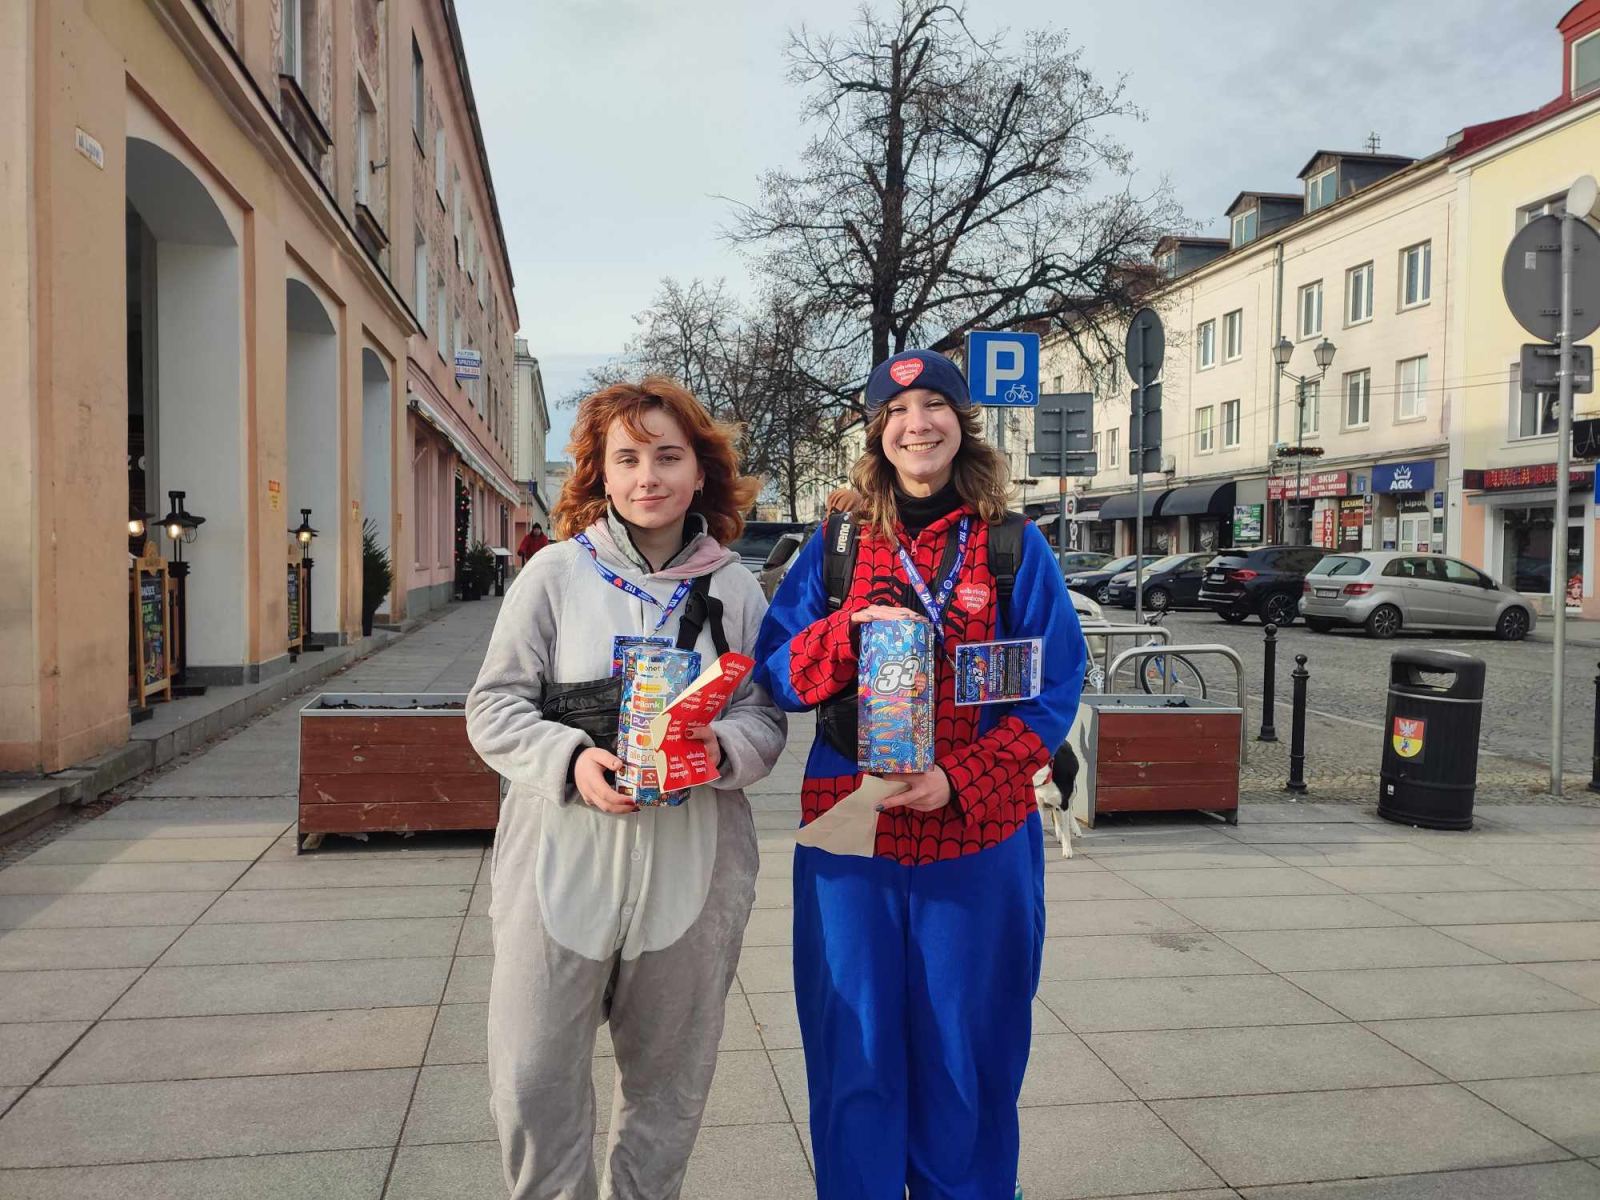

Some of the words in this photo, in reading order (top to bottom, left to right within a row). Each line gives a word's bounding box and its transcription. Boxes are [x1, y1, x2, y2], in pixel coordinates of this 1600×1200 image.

[986, 340, 1025, 397] P
[1285, 478, 1309, 489] KANOR
[1318, 473, 1339, 484] SKUP
[1389, 479, 1413, 491] AGK
[836, 522, 851, 553] arena
[624, 582, 638, 594] 112
[874, 655, 922, 695] 33
[632, 716, 651, 727] PLA
